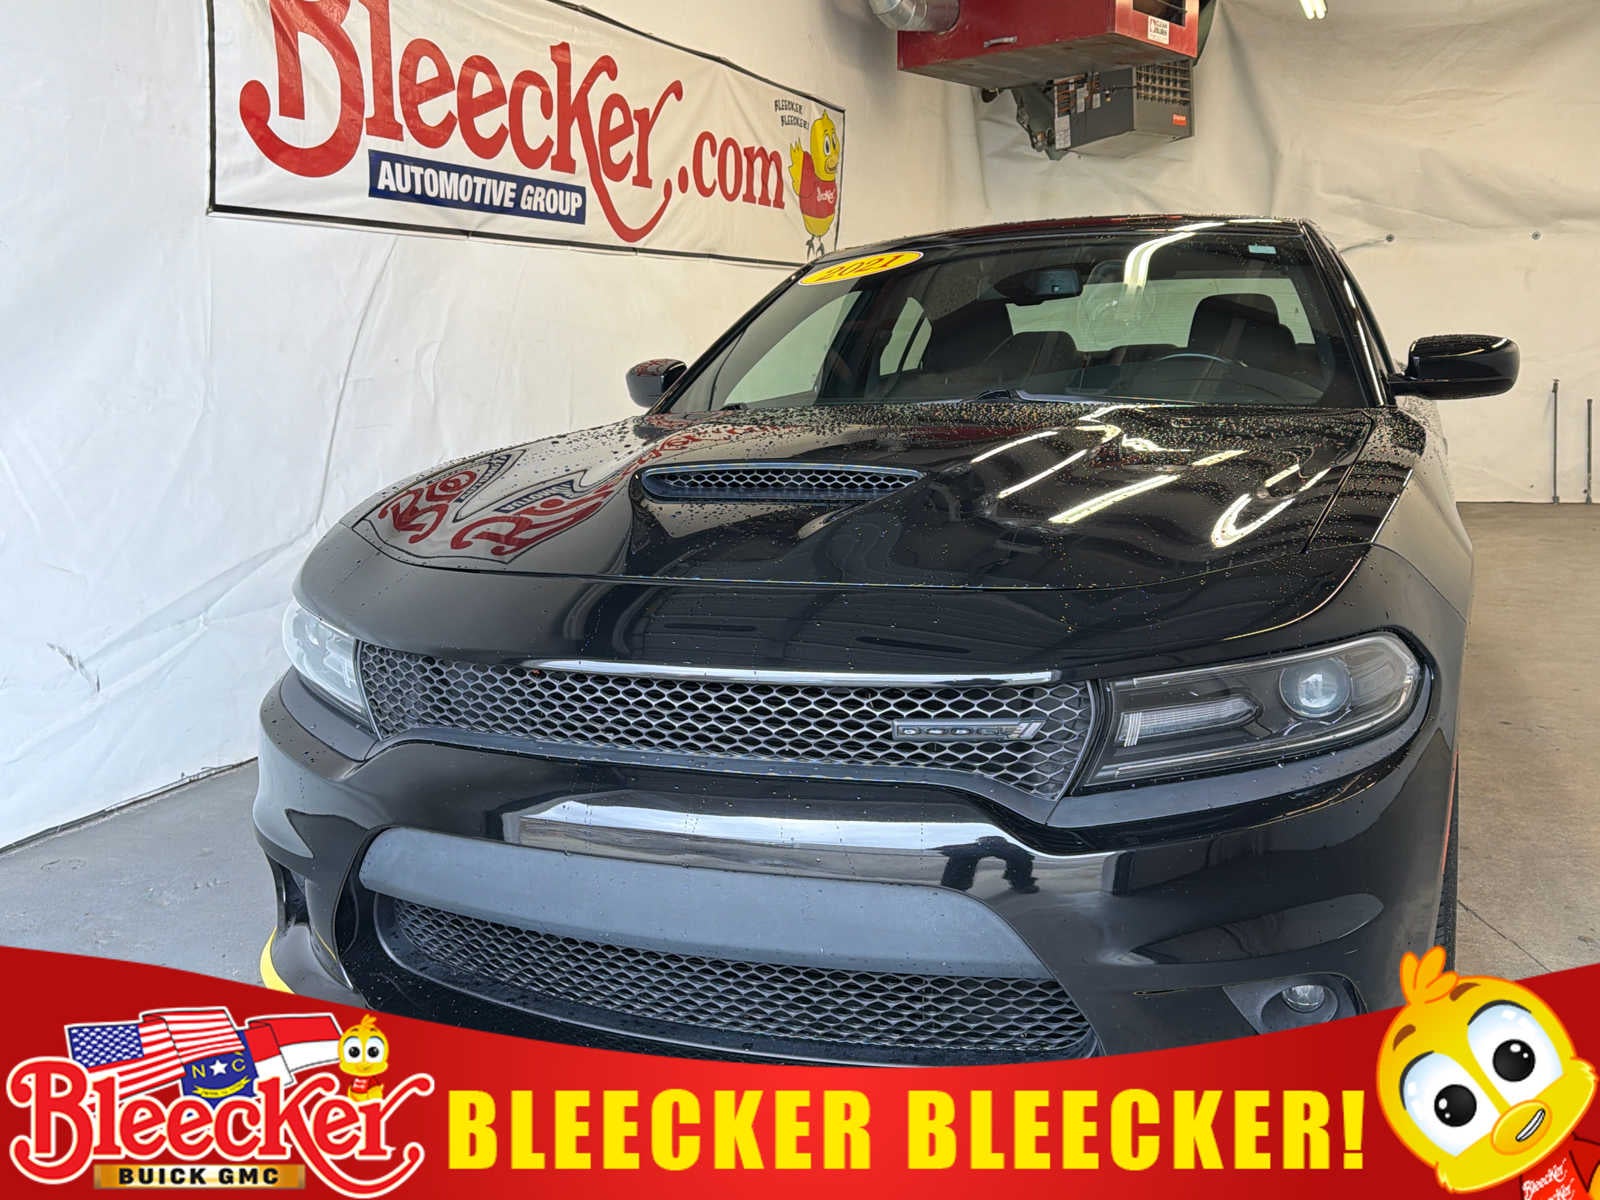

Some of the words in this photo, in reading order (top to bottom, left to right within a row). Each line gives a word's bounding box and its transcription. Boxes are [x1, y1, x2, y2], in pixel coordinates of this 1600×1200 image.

[377, 160, 517, 209] AUTOMOTIVE
[520, 184, 583, 217] GROUP
[815, 253, 905, 282] 2021
